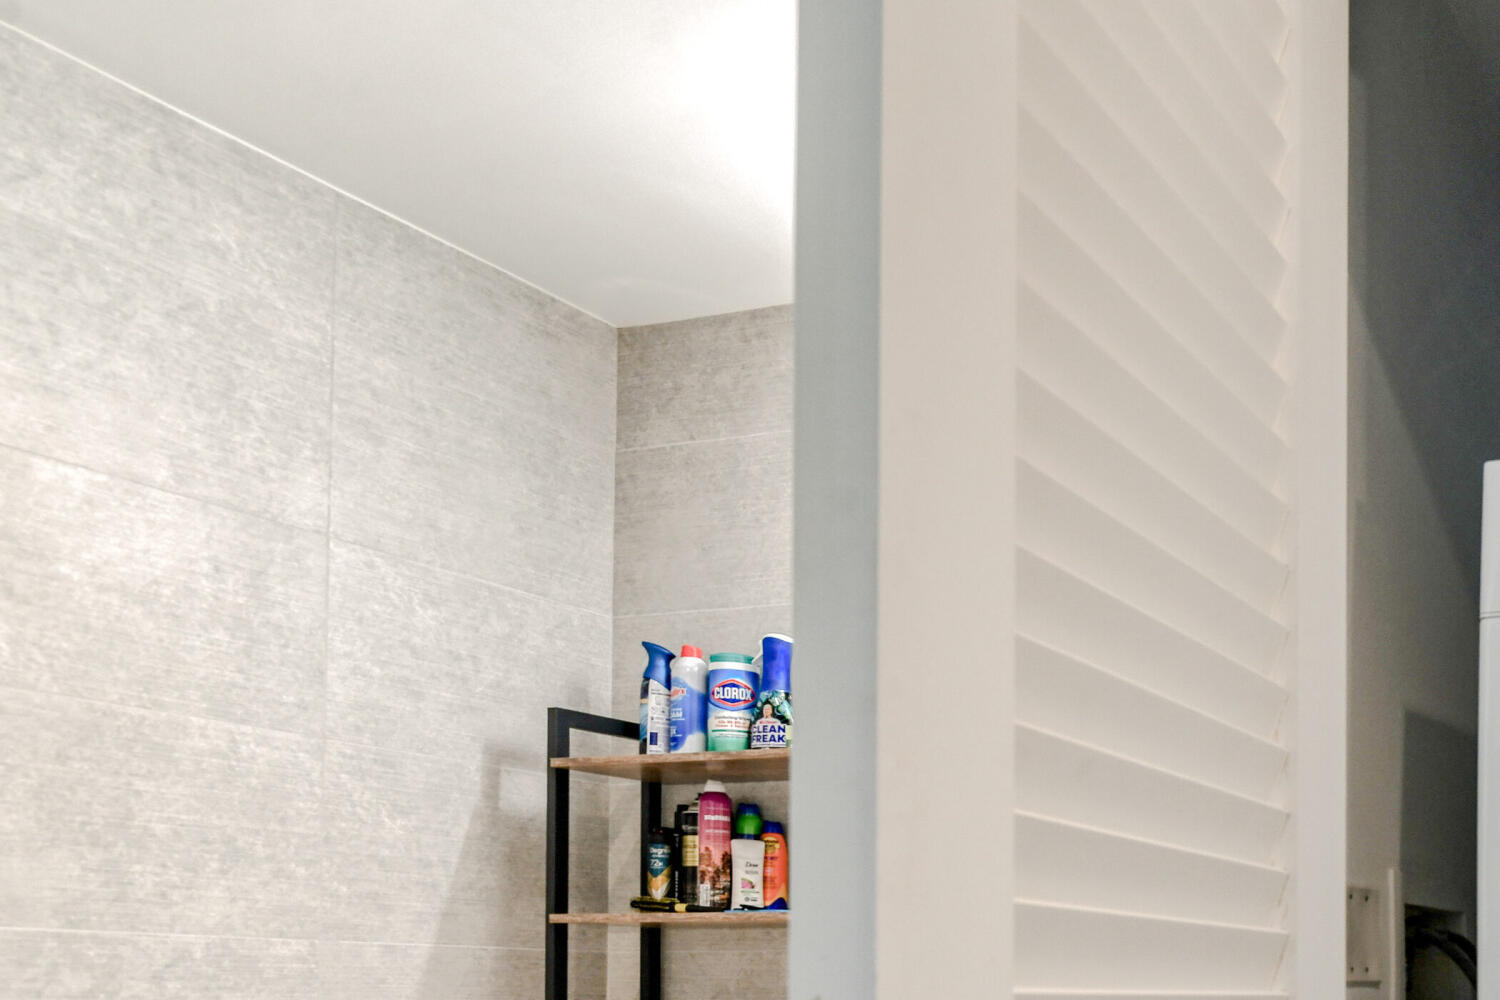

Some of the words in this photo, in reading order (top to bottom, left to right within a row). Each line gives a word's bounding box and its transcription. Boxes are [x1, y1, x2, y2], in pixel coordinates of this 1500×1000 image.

[714, 687, 752, 700] CLOROX
[751, 724, 786, 734] CLEAN
[751, 734, 786, 743] FREAK
